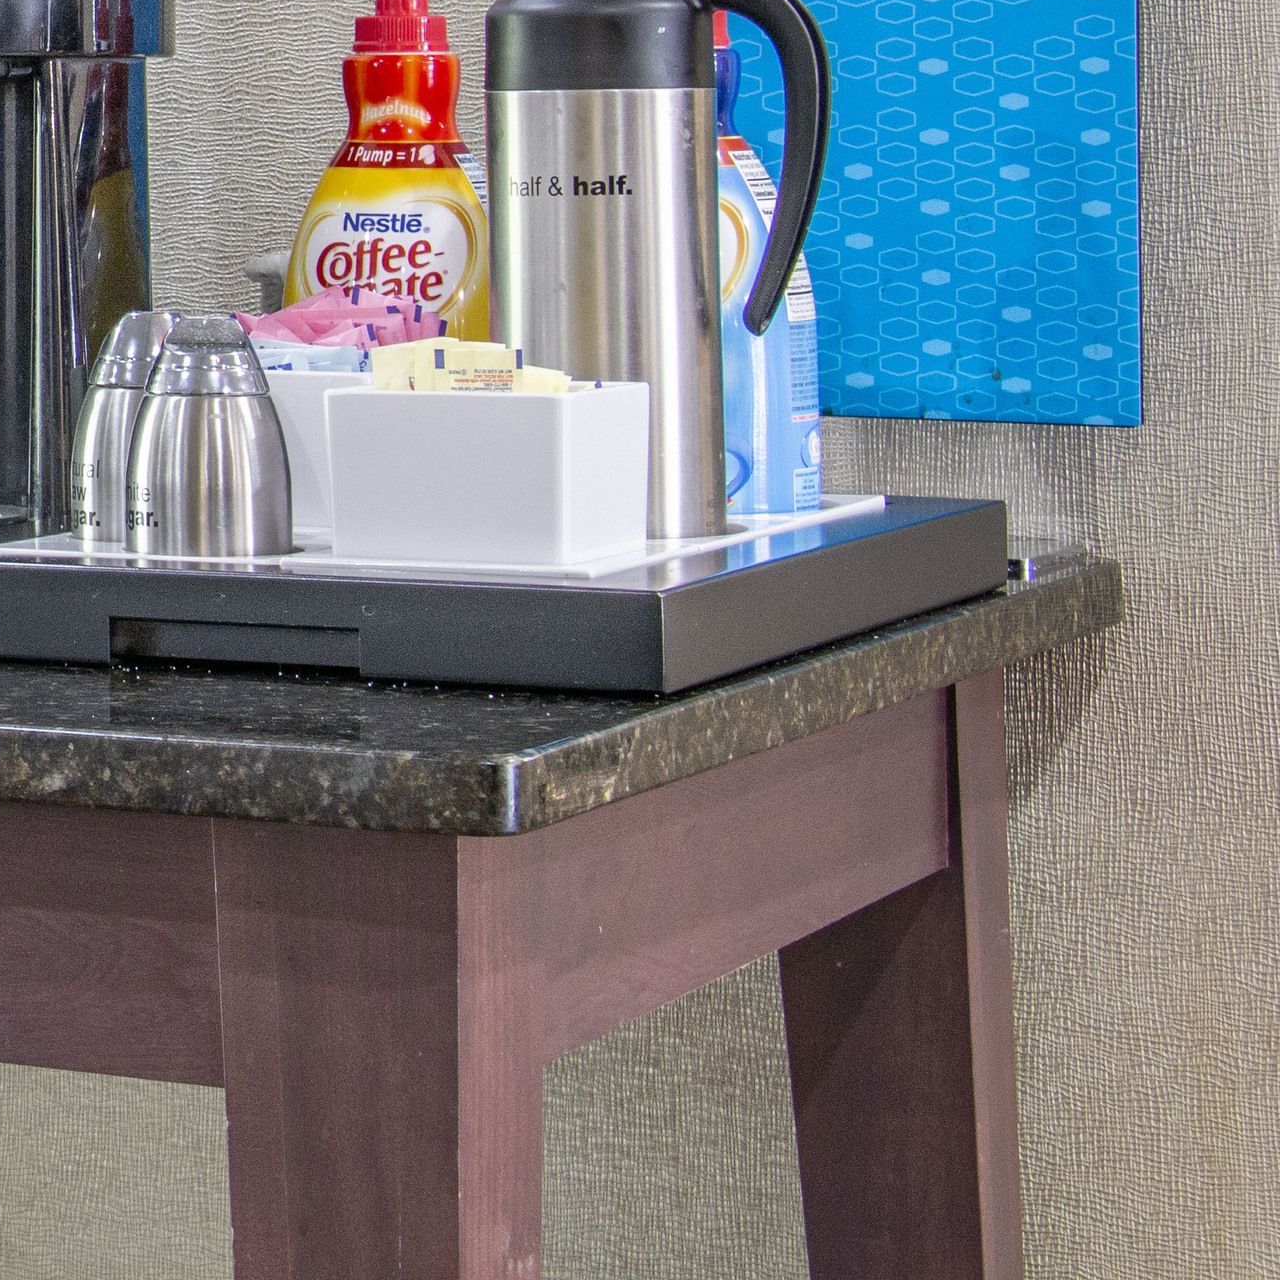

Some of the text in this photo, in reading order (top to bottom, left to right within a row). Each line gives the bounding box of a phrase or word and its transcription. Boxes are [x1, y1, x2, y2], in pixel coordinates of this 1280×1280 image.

[347, 146, 354, 161] 1
[354, 146, 393, 165] Pump
[510, 176, 542, 197] half
[548, 176, 563, 197] &
[573, 175, 632, 196] half.
[72, 459, 100, 478] tural
[71, 484, 87, 501] aw
[73, 510, 100, 529] gar.
[128, 509, 159, 530] gar.
